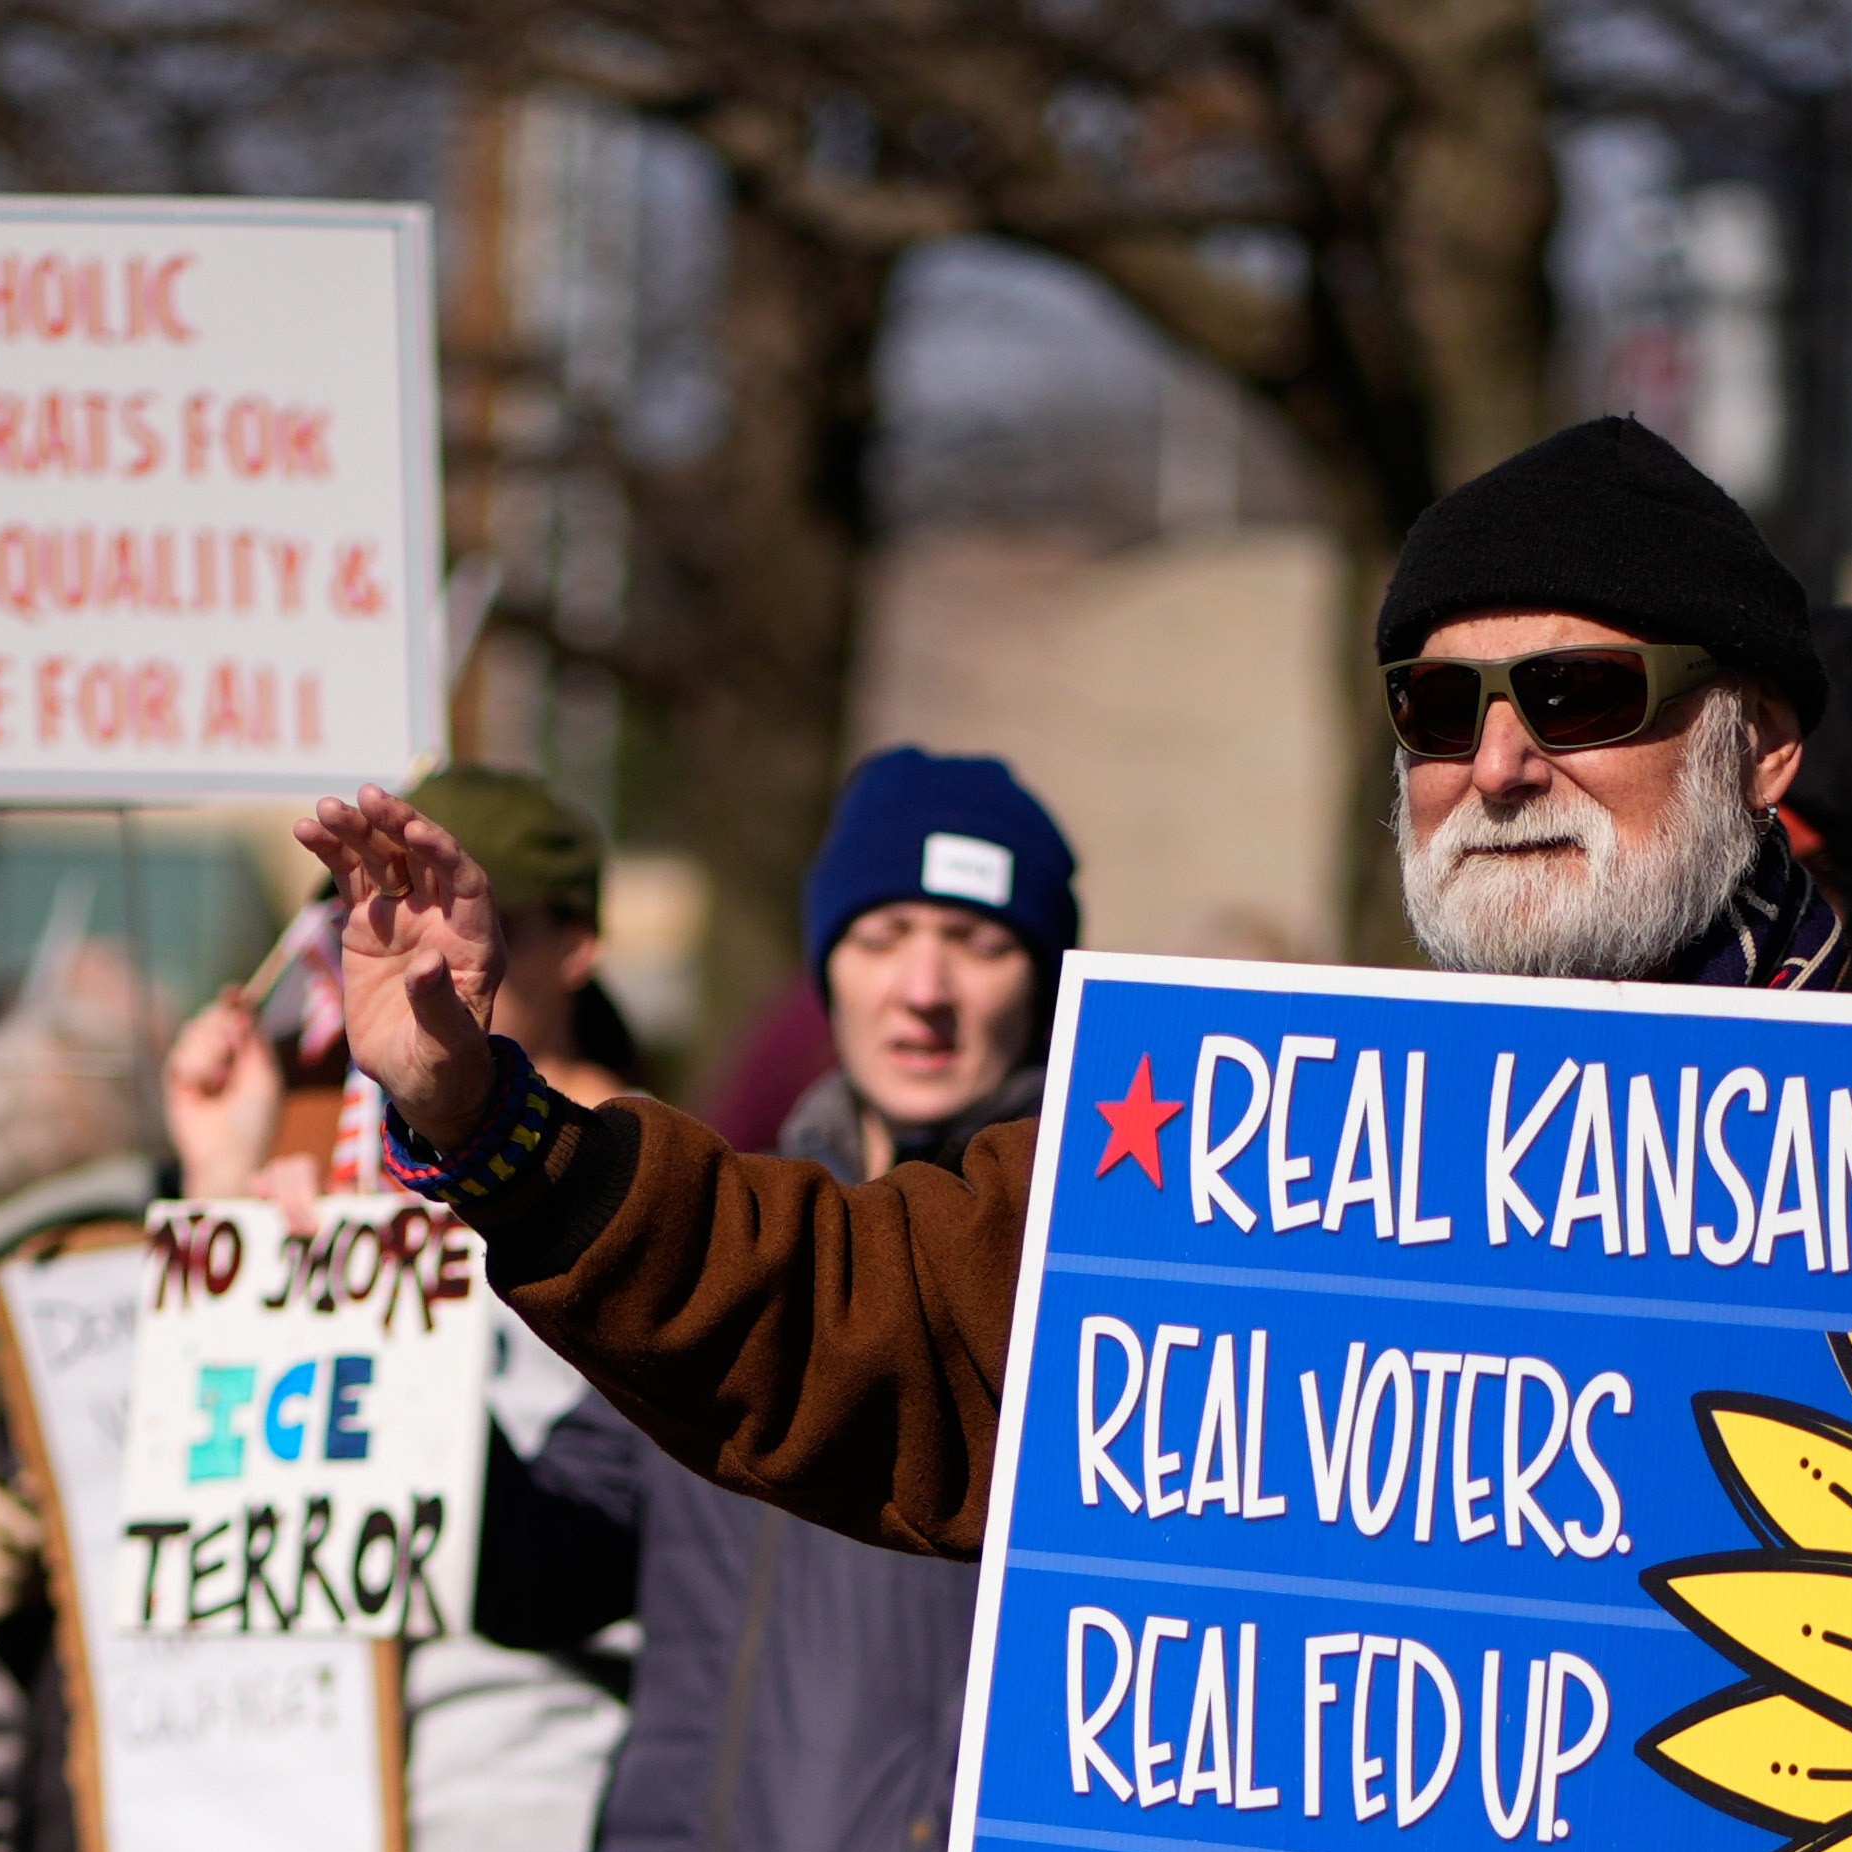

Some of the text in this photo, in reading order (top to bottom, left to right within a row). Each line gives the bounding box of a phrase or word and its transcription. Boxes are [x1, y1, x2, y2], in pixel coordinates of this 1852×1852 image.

[181, 395, 336, 483] FOR
[331, 541, 392, 622] &
[33, 655, 184, 750] FOR
[202, 661, 326, 750] ALL
[1189, 1032, 1452, 1247] REAL
[146, 1212, 243, 1310] NO
[264, 1205, 472, 1339] MORE
[187, 1354, 375, 1484] ICE
[1077, 1315, 1634, 1560] REAL VOTERS.
[125, 1494, 447, 1636] TERROR
[1066, 1605, 1611, 1846] REAL FED UP.
